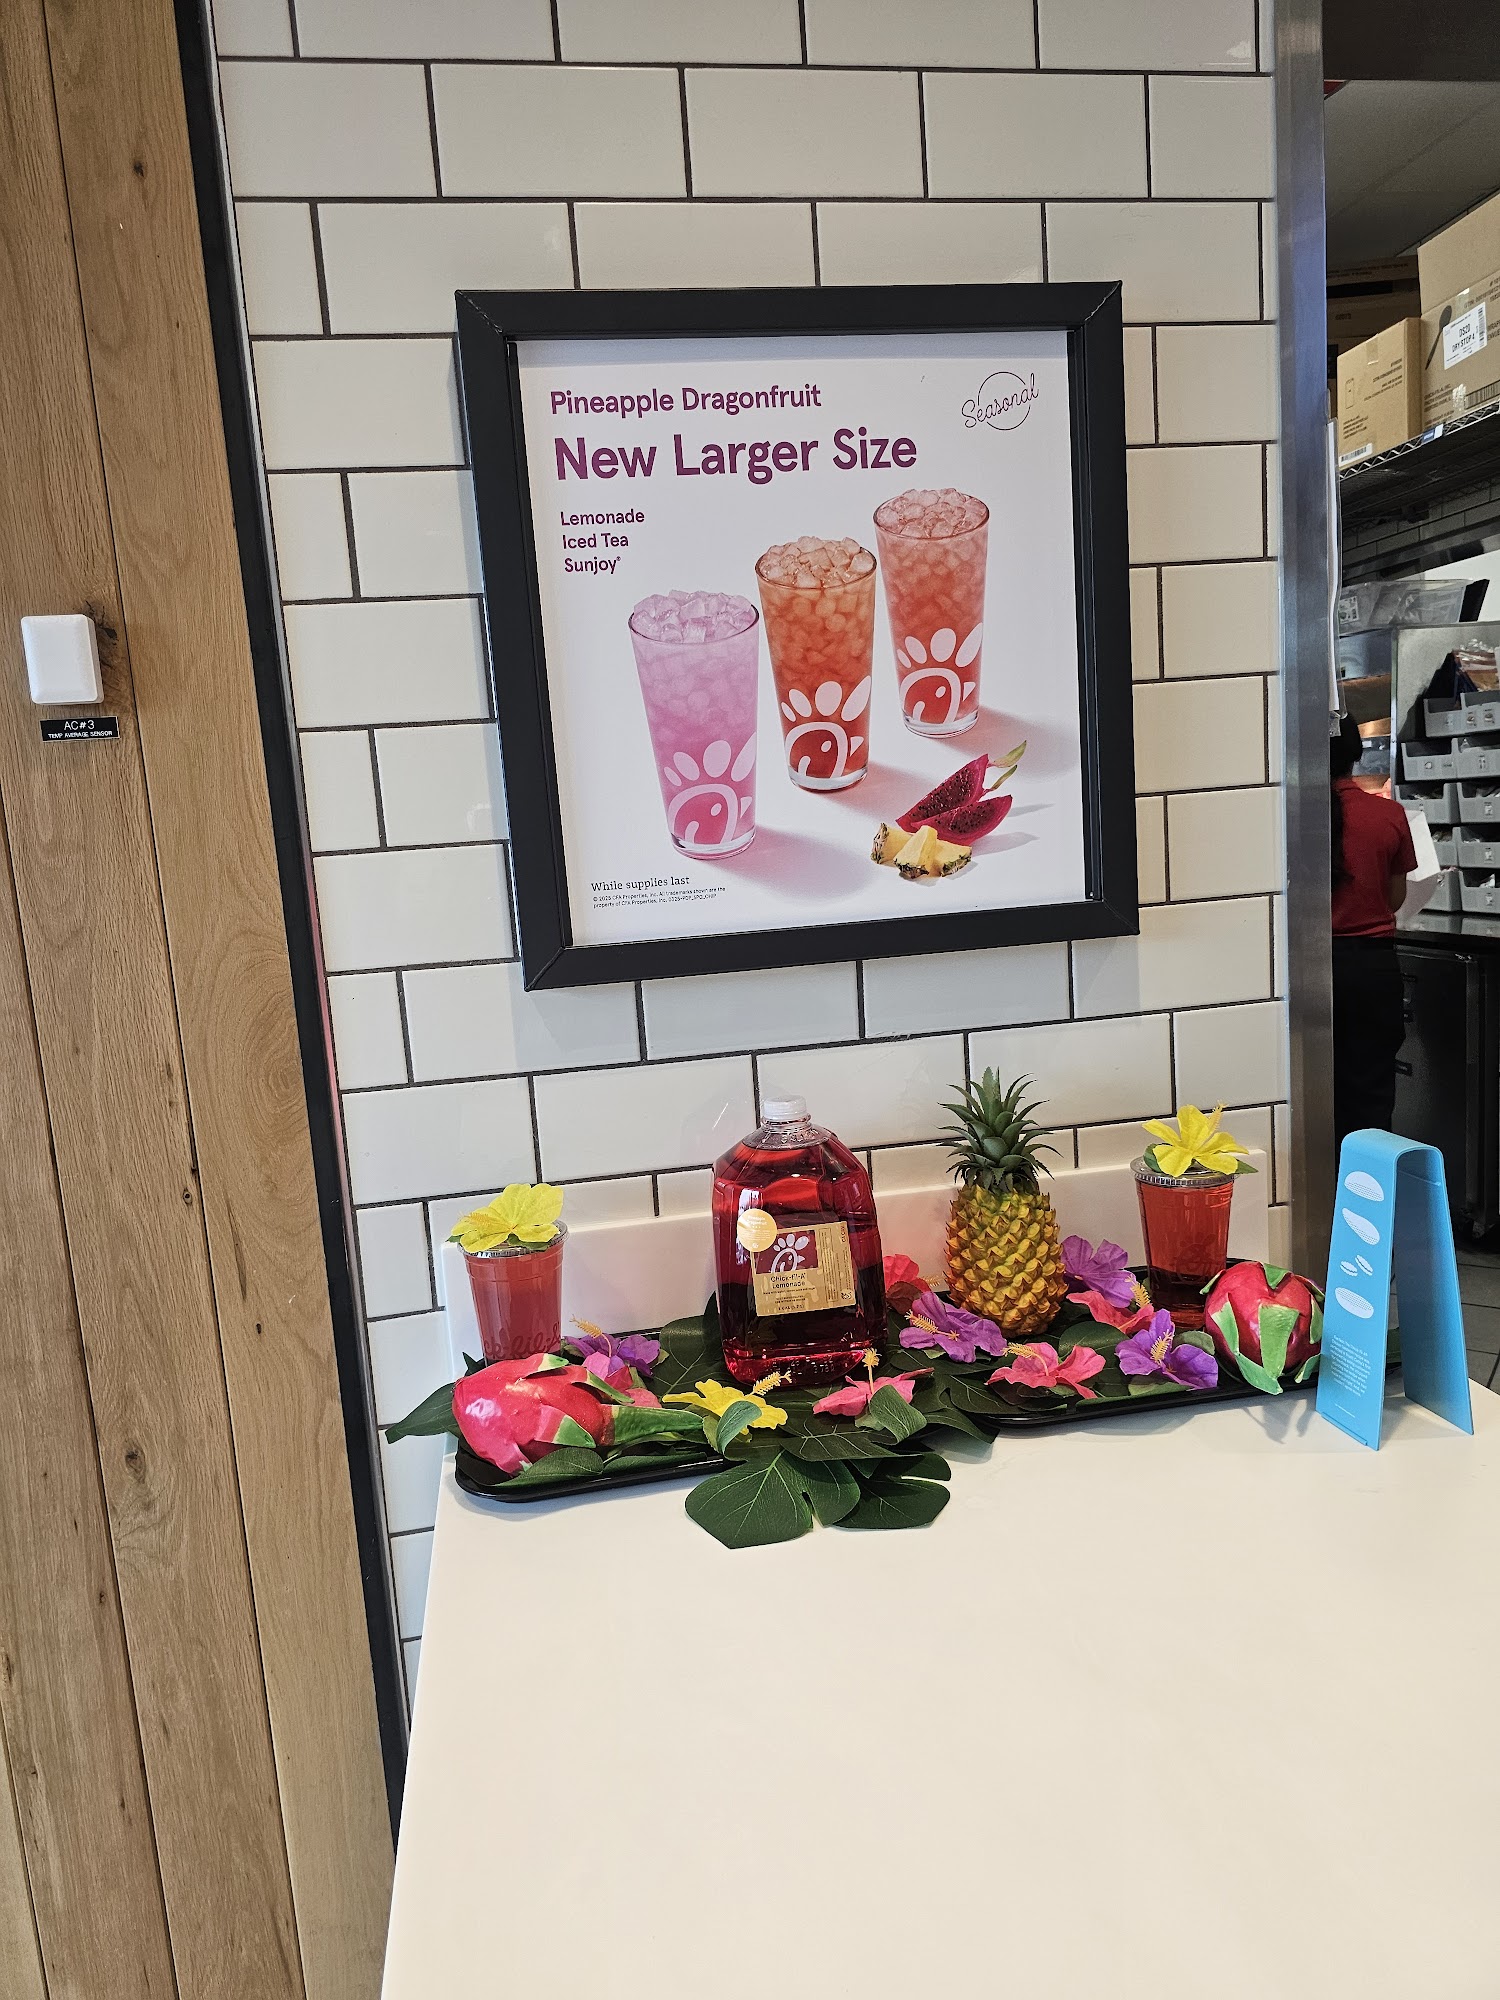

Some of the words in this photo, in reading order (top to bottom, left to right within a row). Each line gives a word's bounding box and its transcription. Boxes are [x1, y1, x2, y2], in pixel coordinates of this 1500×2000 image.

[550, 388, 675, 419] Pineapple
[682, 383, 822, 415] Dragonfruit
[961, 372, 1040, 428] Seasonal
[554, 436, 658, 480] New
[674, 433, 819, 484] Larger
[832, 426, 917, 470] Size
[560, 508, 645, 526] Lemonade
[562, 533, 597, 549] Iced
[600, 532, 629, 548] Tea
[64, 731, 90, 739] AVERAGE
[591, 880, 623, 891] While
[626, 877, 668, 891] supplies
[670, 876, 690, 886] last
